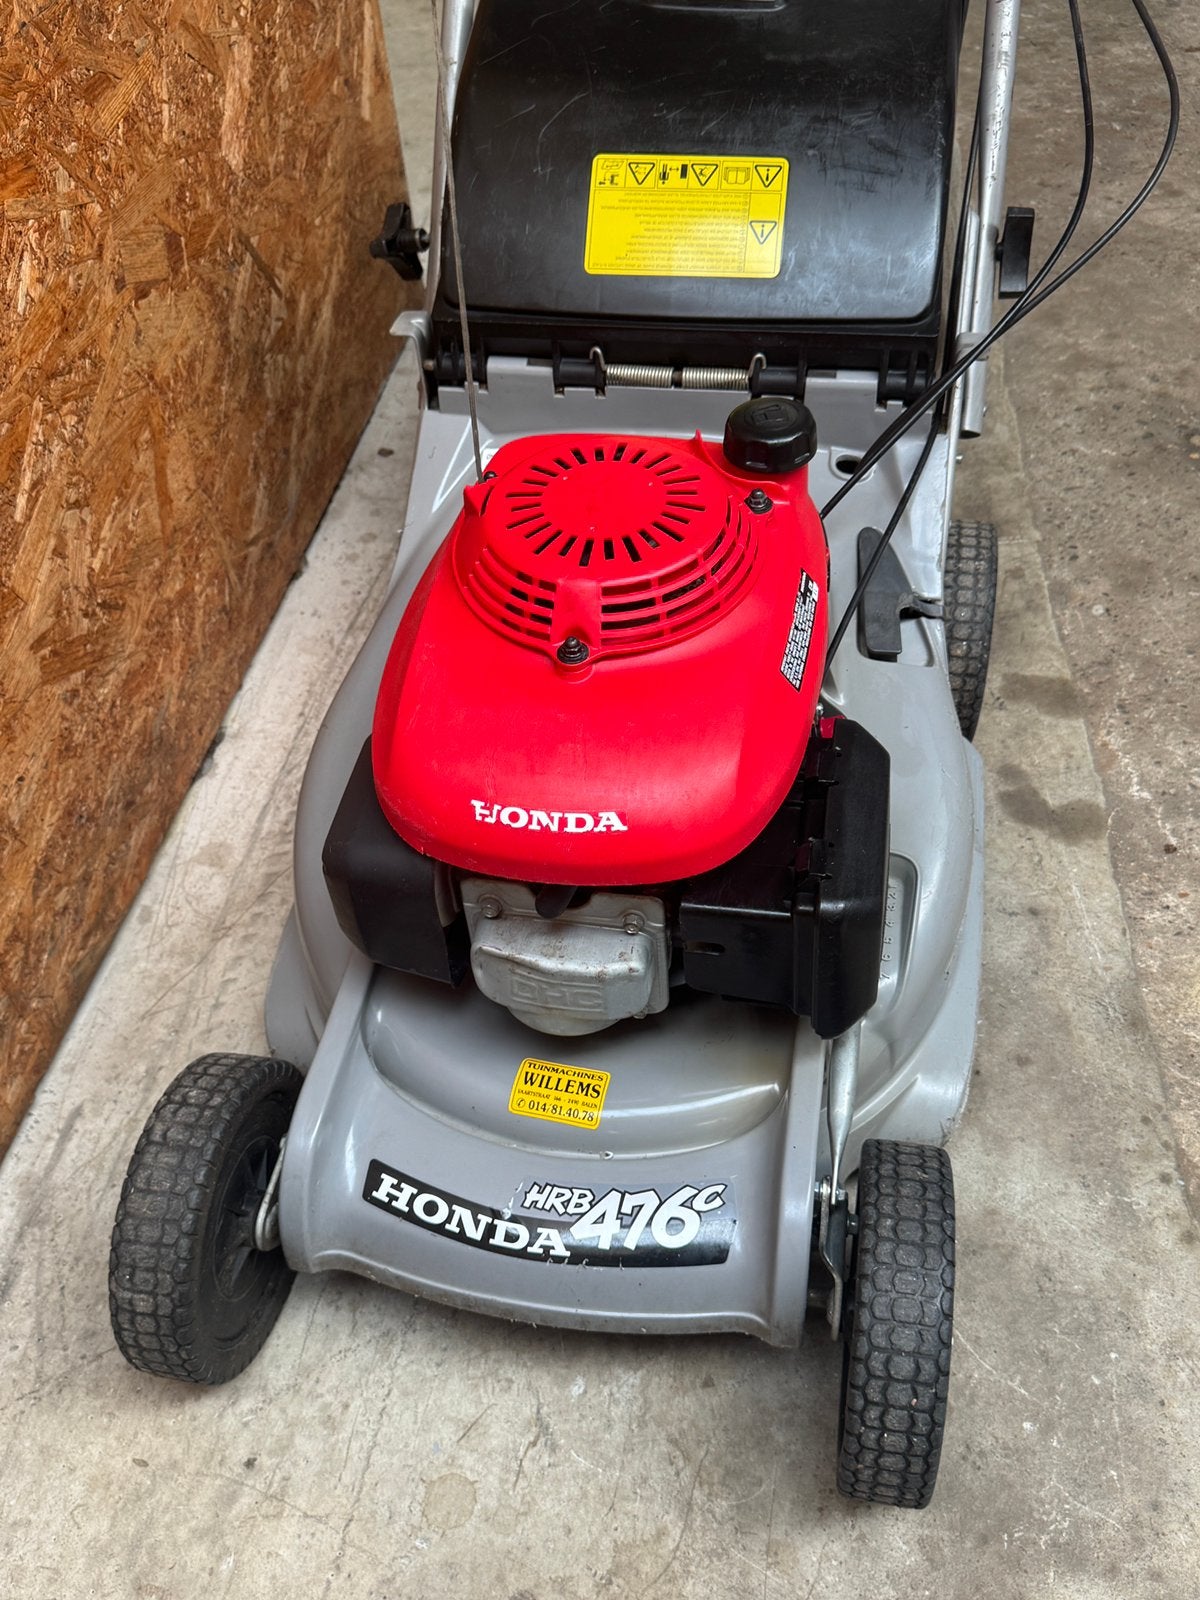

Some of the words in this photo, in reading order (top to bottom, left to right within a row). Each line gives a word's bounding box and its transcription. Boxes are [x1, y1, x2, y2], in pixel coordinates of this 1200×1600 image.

[470, 799, 628, 833] HONDA
[523, 1071, 602, 1099] WILLEMS
[528, 1062, 603, 1082] TUINMACHINES
[528, 1100, 594, 1122] 014/81.40.78
[370, 1172, 571, 1257] HONDA
